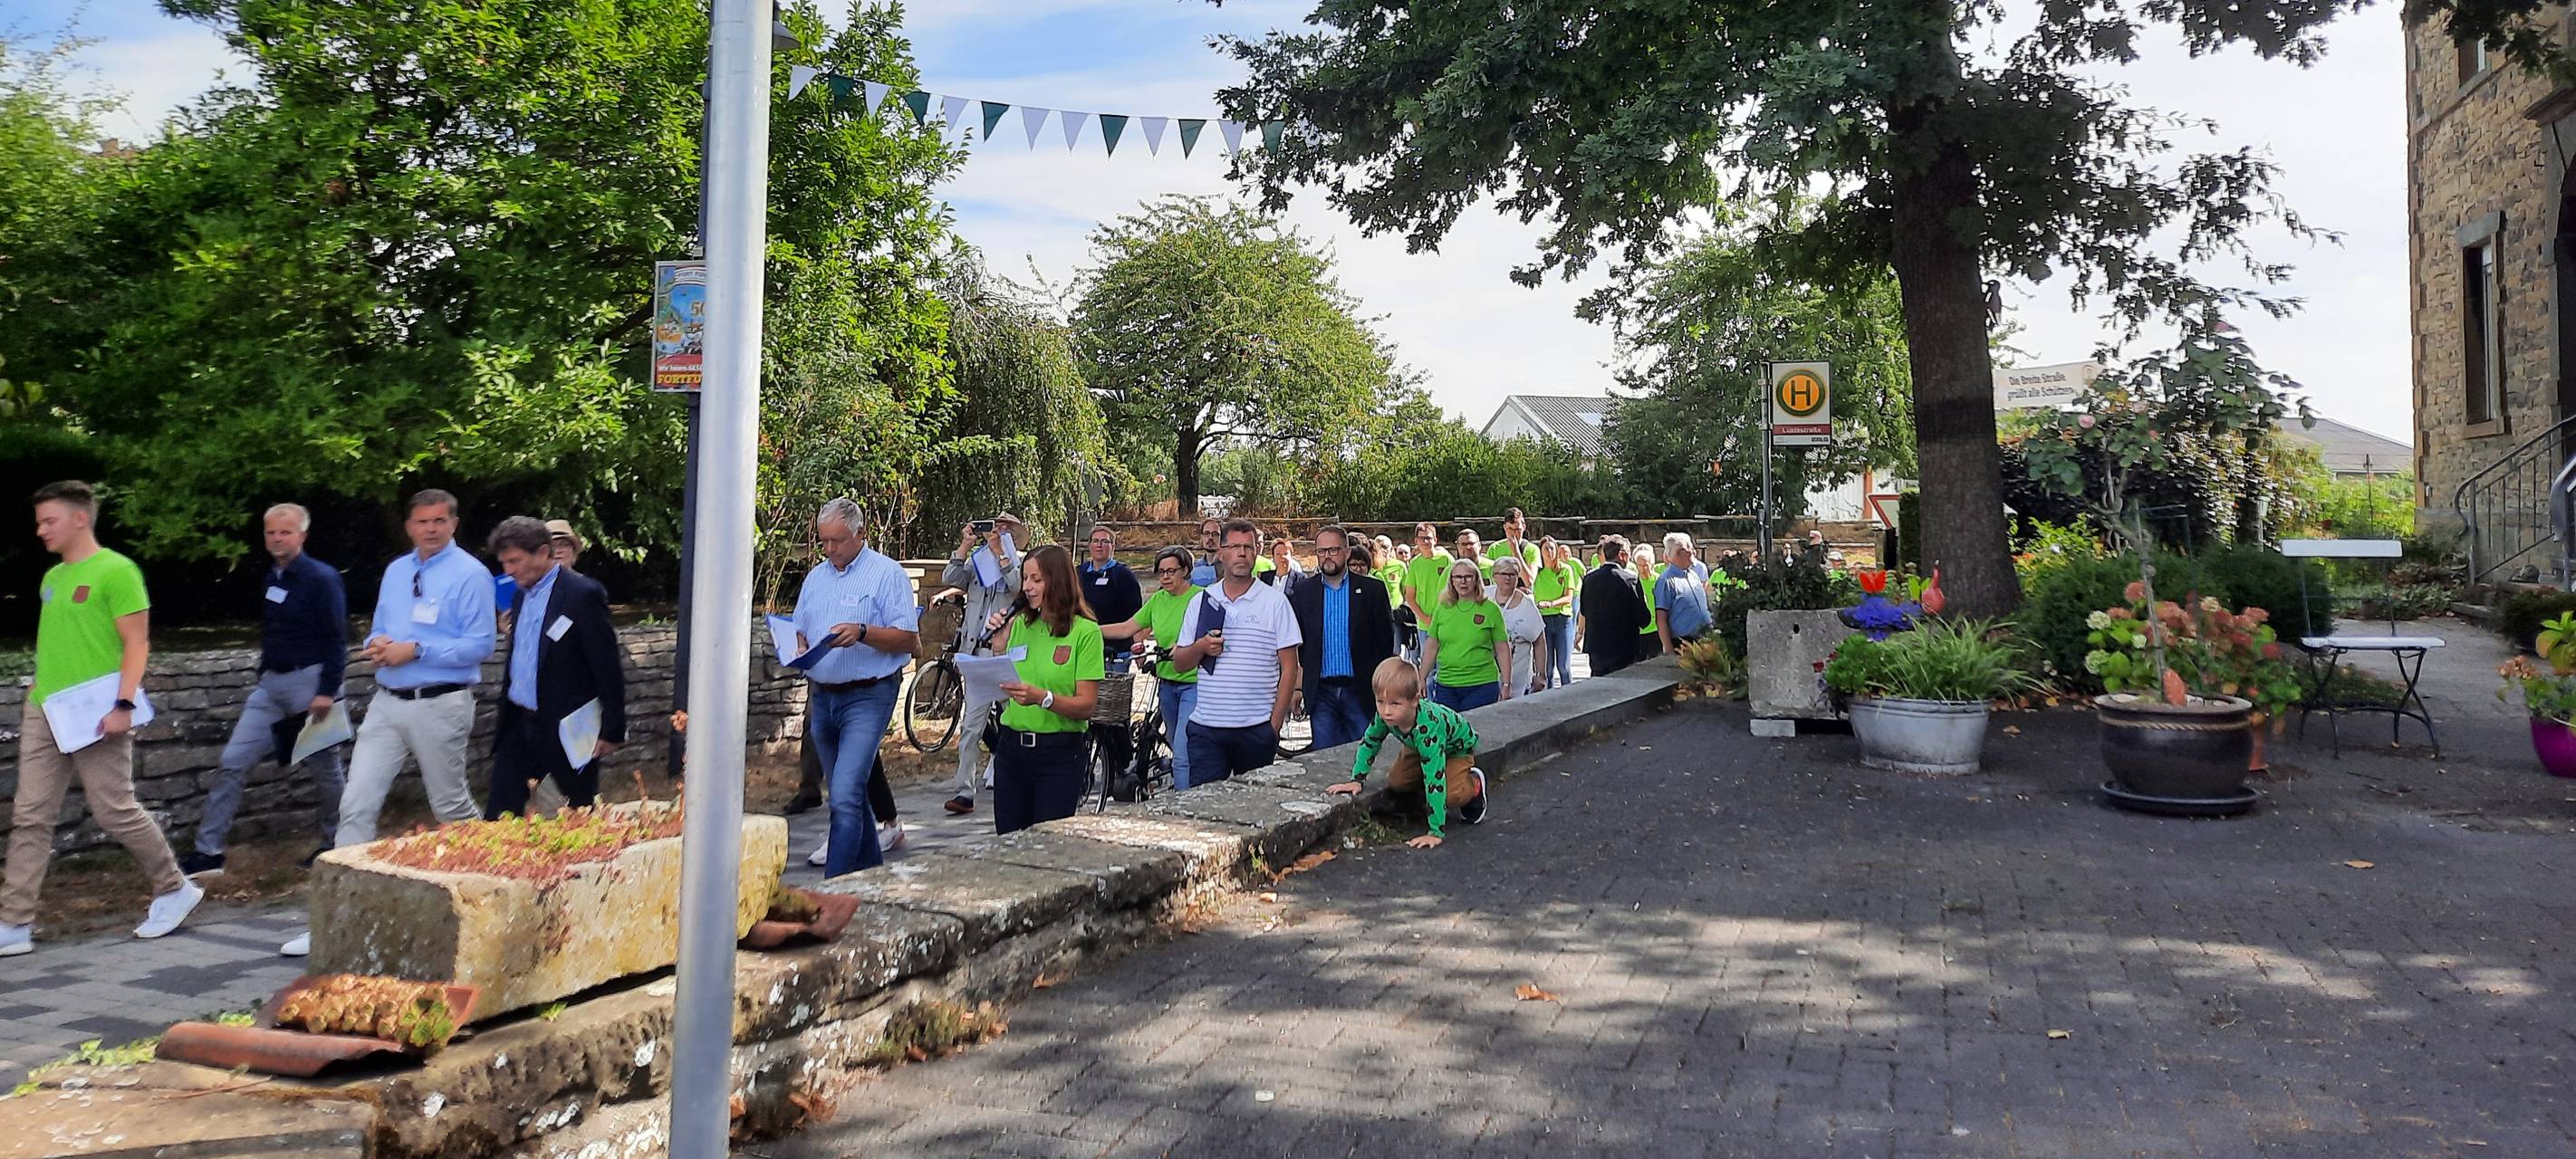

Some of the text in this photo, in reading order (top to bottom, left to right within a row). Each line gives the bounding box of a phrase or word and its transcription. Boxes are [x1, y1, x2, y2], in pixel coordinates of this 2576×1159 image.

[657, 373, 702, 384] FORTFU
[2042, 371, 2066, 383] Straße
[1791, 379, 1811, 406] H
